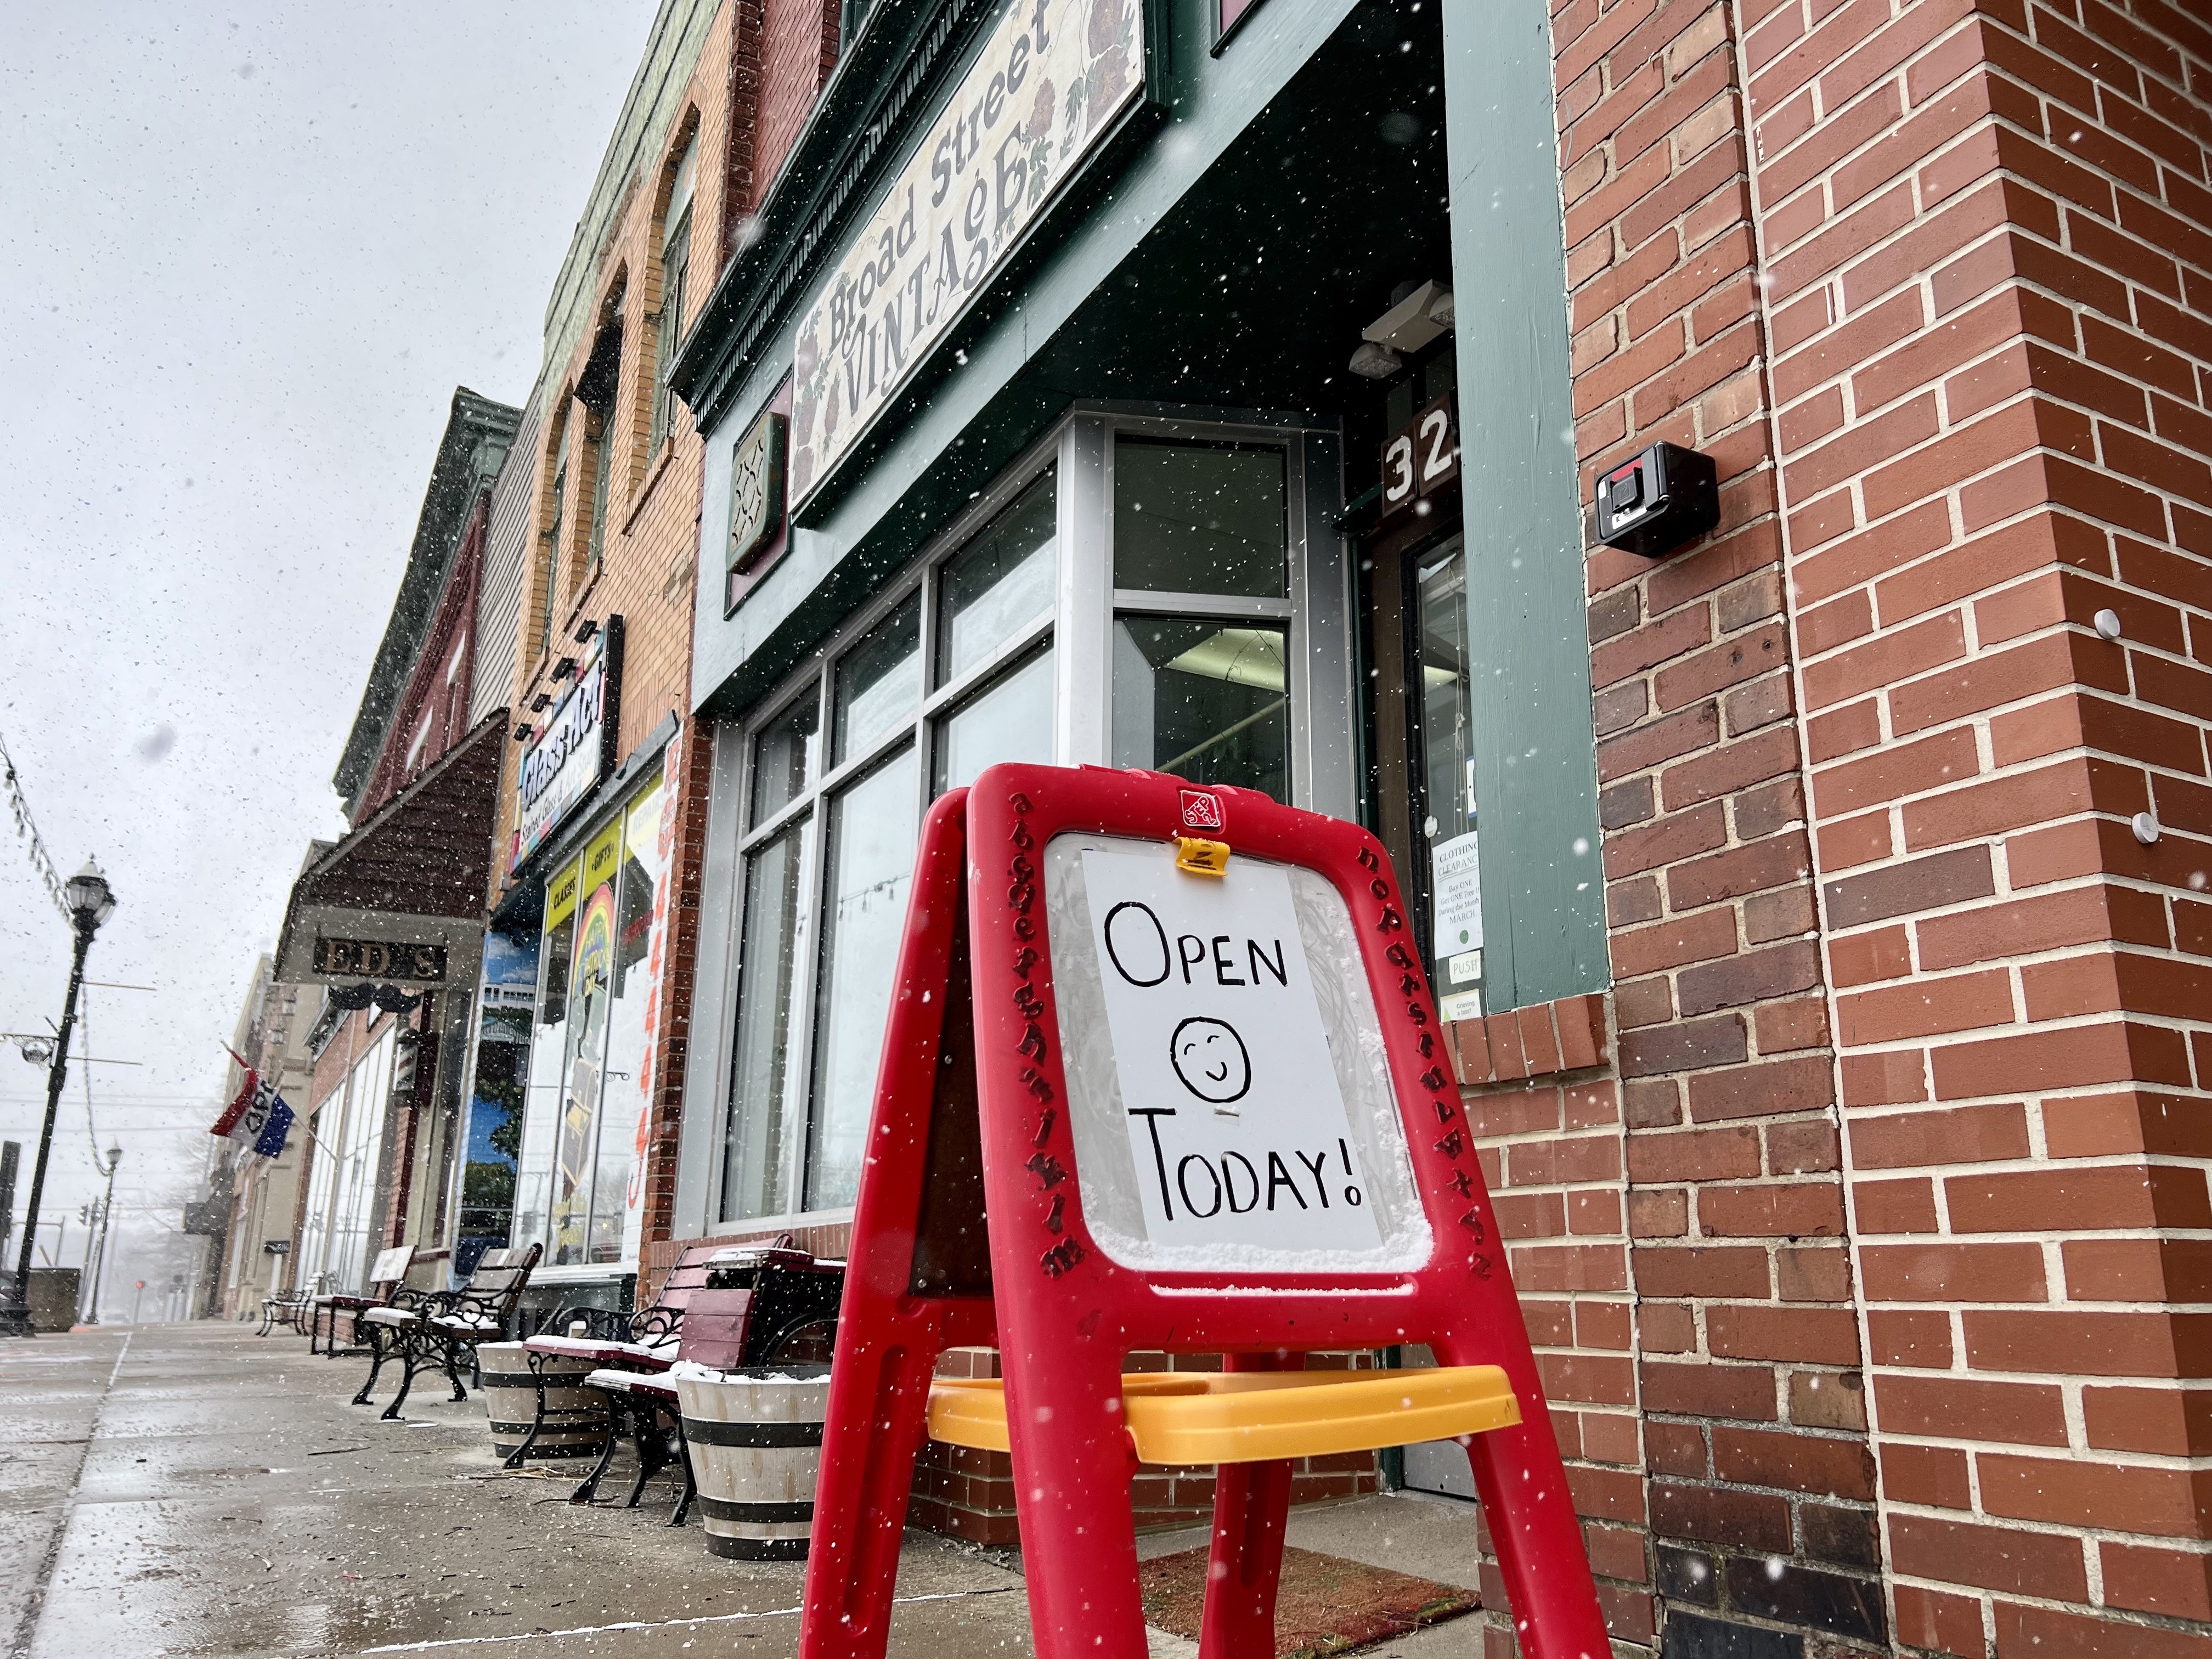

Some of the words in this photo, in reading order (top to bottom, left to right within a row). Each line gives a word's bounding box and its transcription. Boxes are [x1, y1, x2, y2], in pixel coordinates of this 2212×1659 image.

[828, 184, 916, 354] Broad
[932, 0, 1050, 209] Street
[1385, 409, 1453, 502] 32
[1449, 884, 1458, 893] Buy
[1459, 879, 1472, 889] ONE
[1438, 906, 1454, 917] During
[1464, 896, 1480, 907] Month
[1441, 897, 1449, 905] Get
[1451, 892, 1463, 902] ONE
[1464, 889, 1475, 898] Free
[1449, 909, 1475, 924] MARCH
[1104, 901, 1289, 988] OPEN
[1453, 958, 1477, 975] PUSH
[1456, 1000, 1475, 1009] Grieving
[1128, 1108, 1362, 1221] TODAY!
